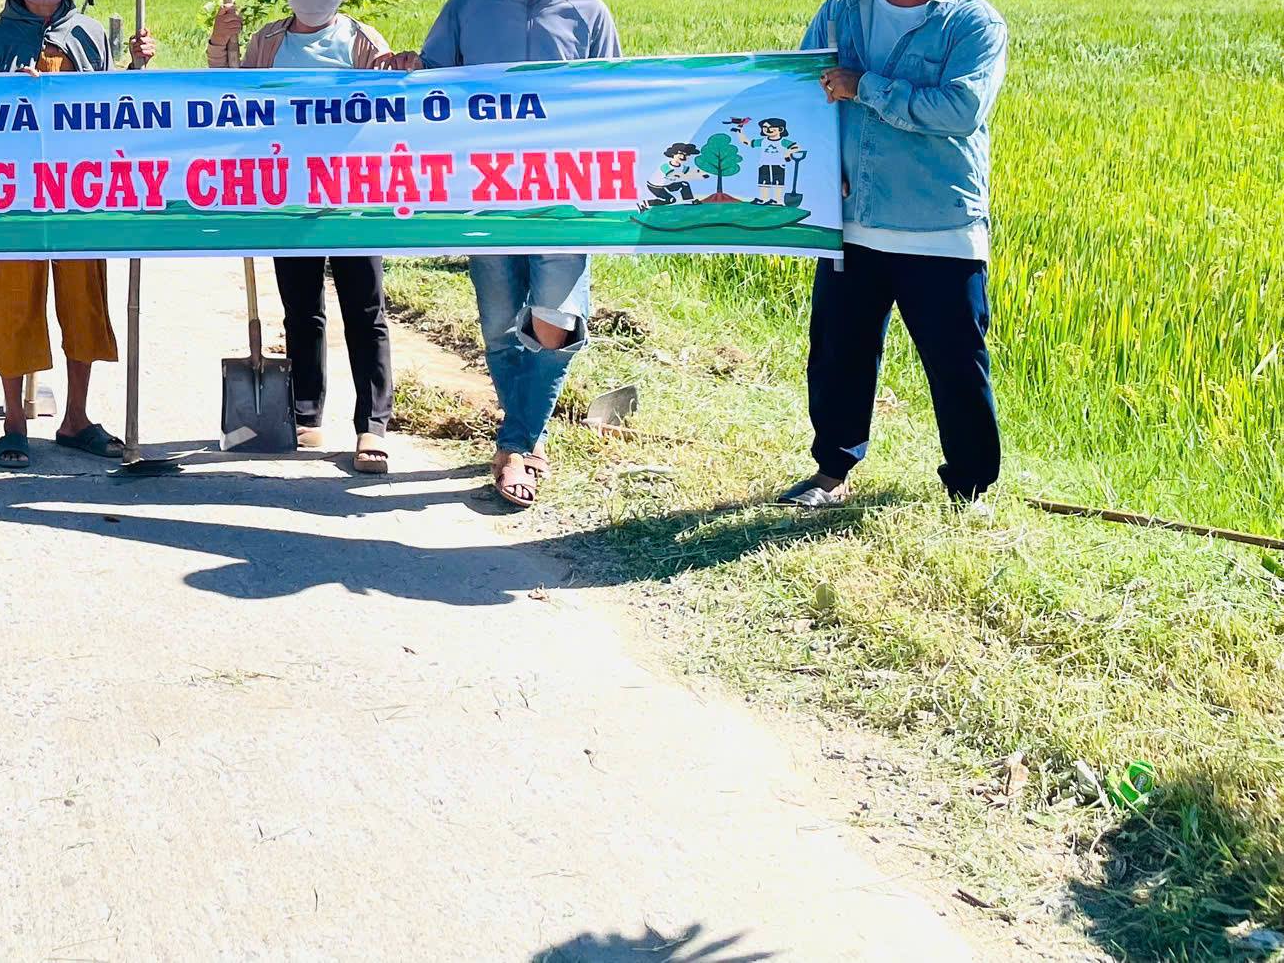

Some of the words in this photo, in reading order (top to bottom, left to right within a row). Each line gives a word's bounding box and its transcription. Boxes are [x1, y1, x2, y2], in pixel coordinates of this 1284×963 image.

[53, 95, 172, 131] NHÂN
[187, 93, 275, 128] DÂN
[290, 91, 406, 126] THÔN
[422, 89, 451, 122] Ô
[468, 93, 546, 121] GIA
[34, 148, 169, 209] NGÀY
[187, 144, 289, 206] CHỦ
[306, 143, 453, 217] NHẬT
[470, 151, 637, 201] XANH
